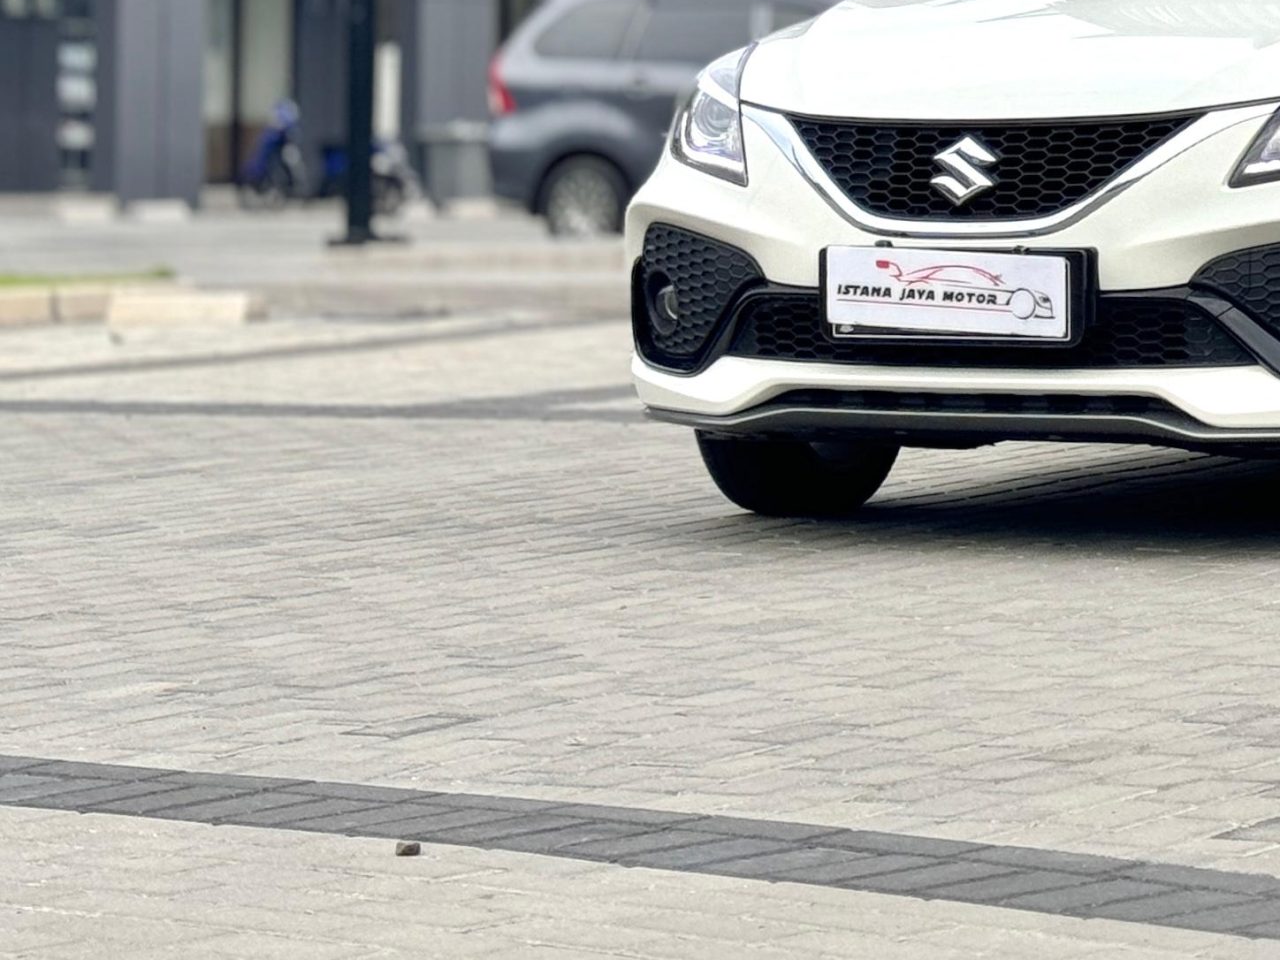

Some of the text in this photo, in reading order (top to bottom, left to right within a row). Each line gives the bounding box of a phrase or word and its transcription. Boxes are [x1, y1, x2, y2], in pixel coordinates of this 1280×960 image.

[837, 284, 997, 306] ISTANA JAYA MOTOR
